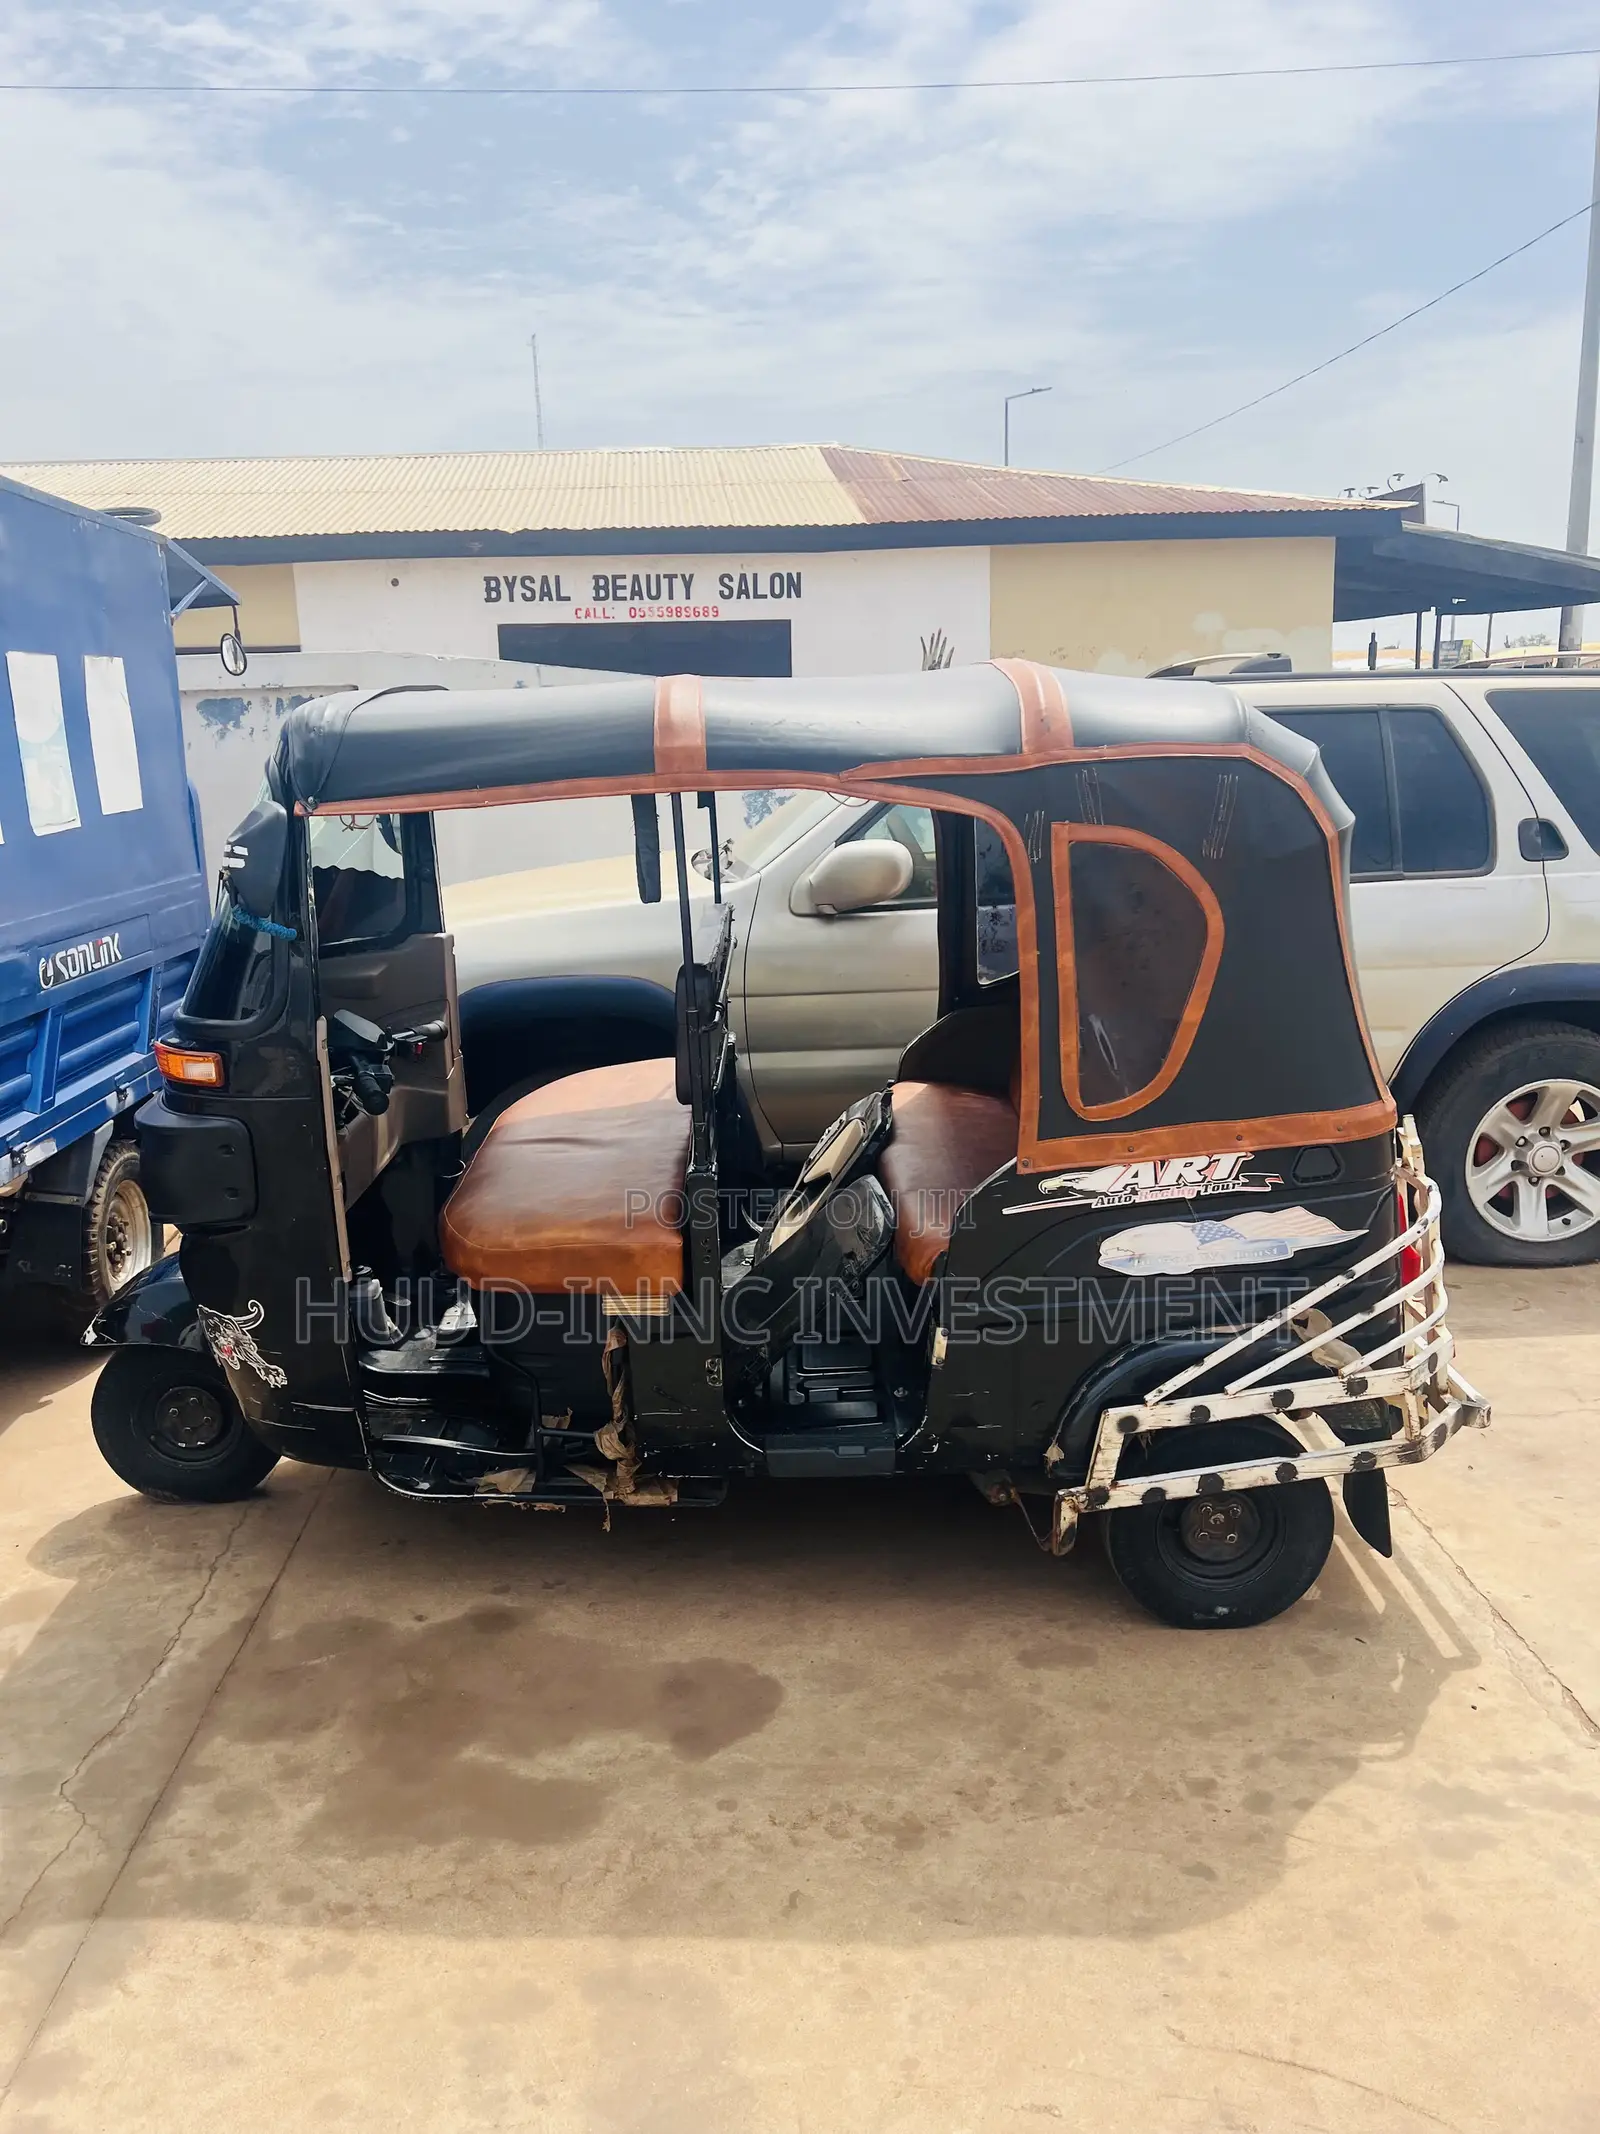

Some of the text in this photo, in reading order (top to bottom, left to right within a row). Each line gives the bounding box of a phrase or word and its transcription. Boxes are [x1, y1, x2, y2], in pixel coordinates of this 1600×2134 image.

[483, 571, 802, 603] BYSAL BEAUTY SALON
[574, 607, 615, 620] CALL:
[1107, 1151, 1252, 1193] ART
[1094, 1194, 1133, 1207] Auto
[1201, 1182, 1241, 1195] Tour
